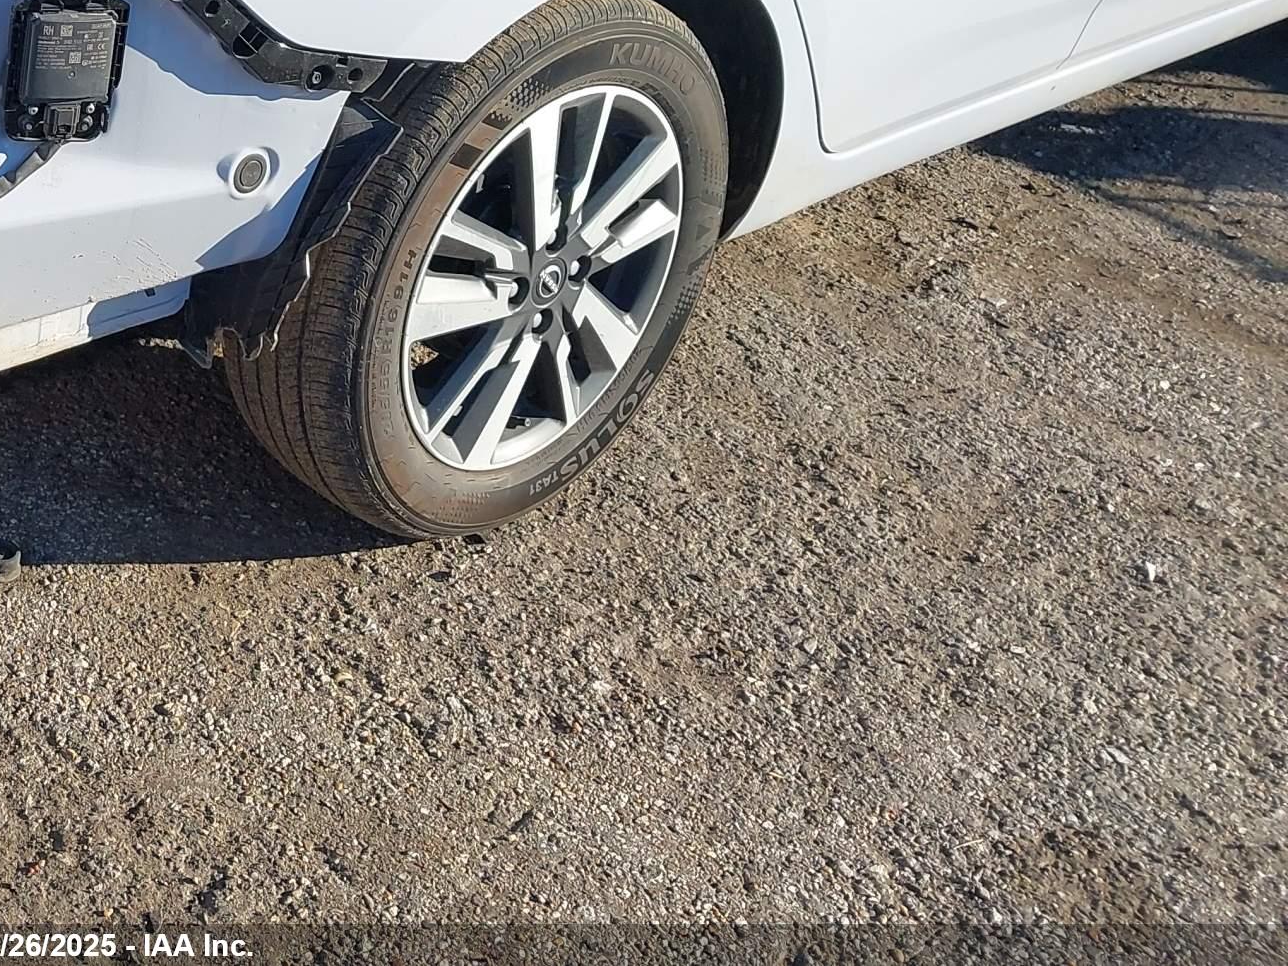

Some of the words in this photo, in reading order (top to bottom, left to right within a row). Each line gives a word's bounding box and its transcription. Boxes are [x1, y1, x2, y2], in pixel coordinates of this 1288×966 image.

[43, 25, 55, 36] RH
[608, 42, 696, 95] KUMHO
[560, 369, 656, 480] SOLUS
[529, 469, 559, 496] TA31
